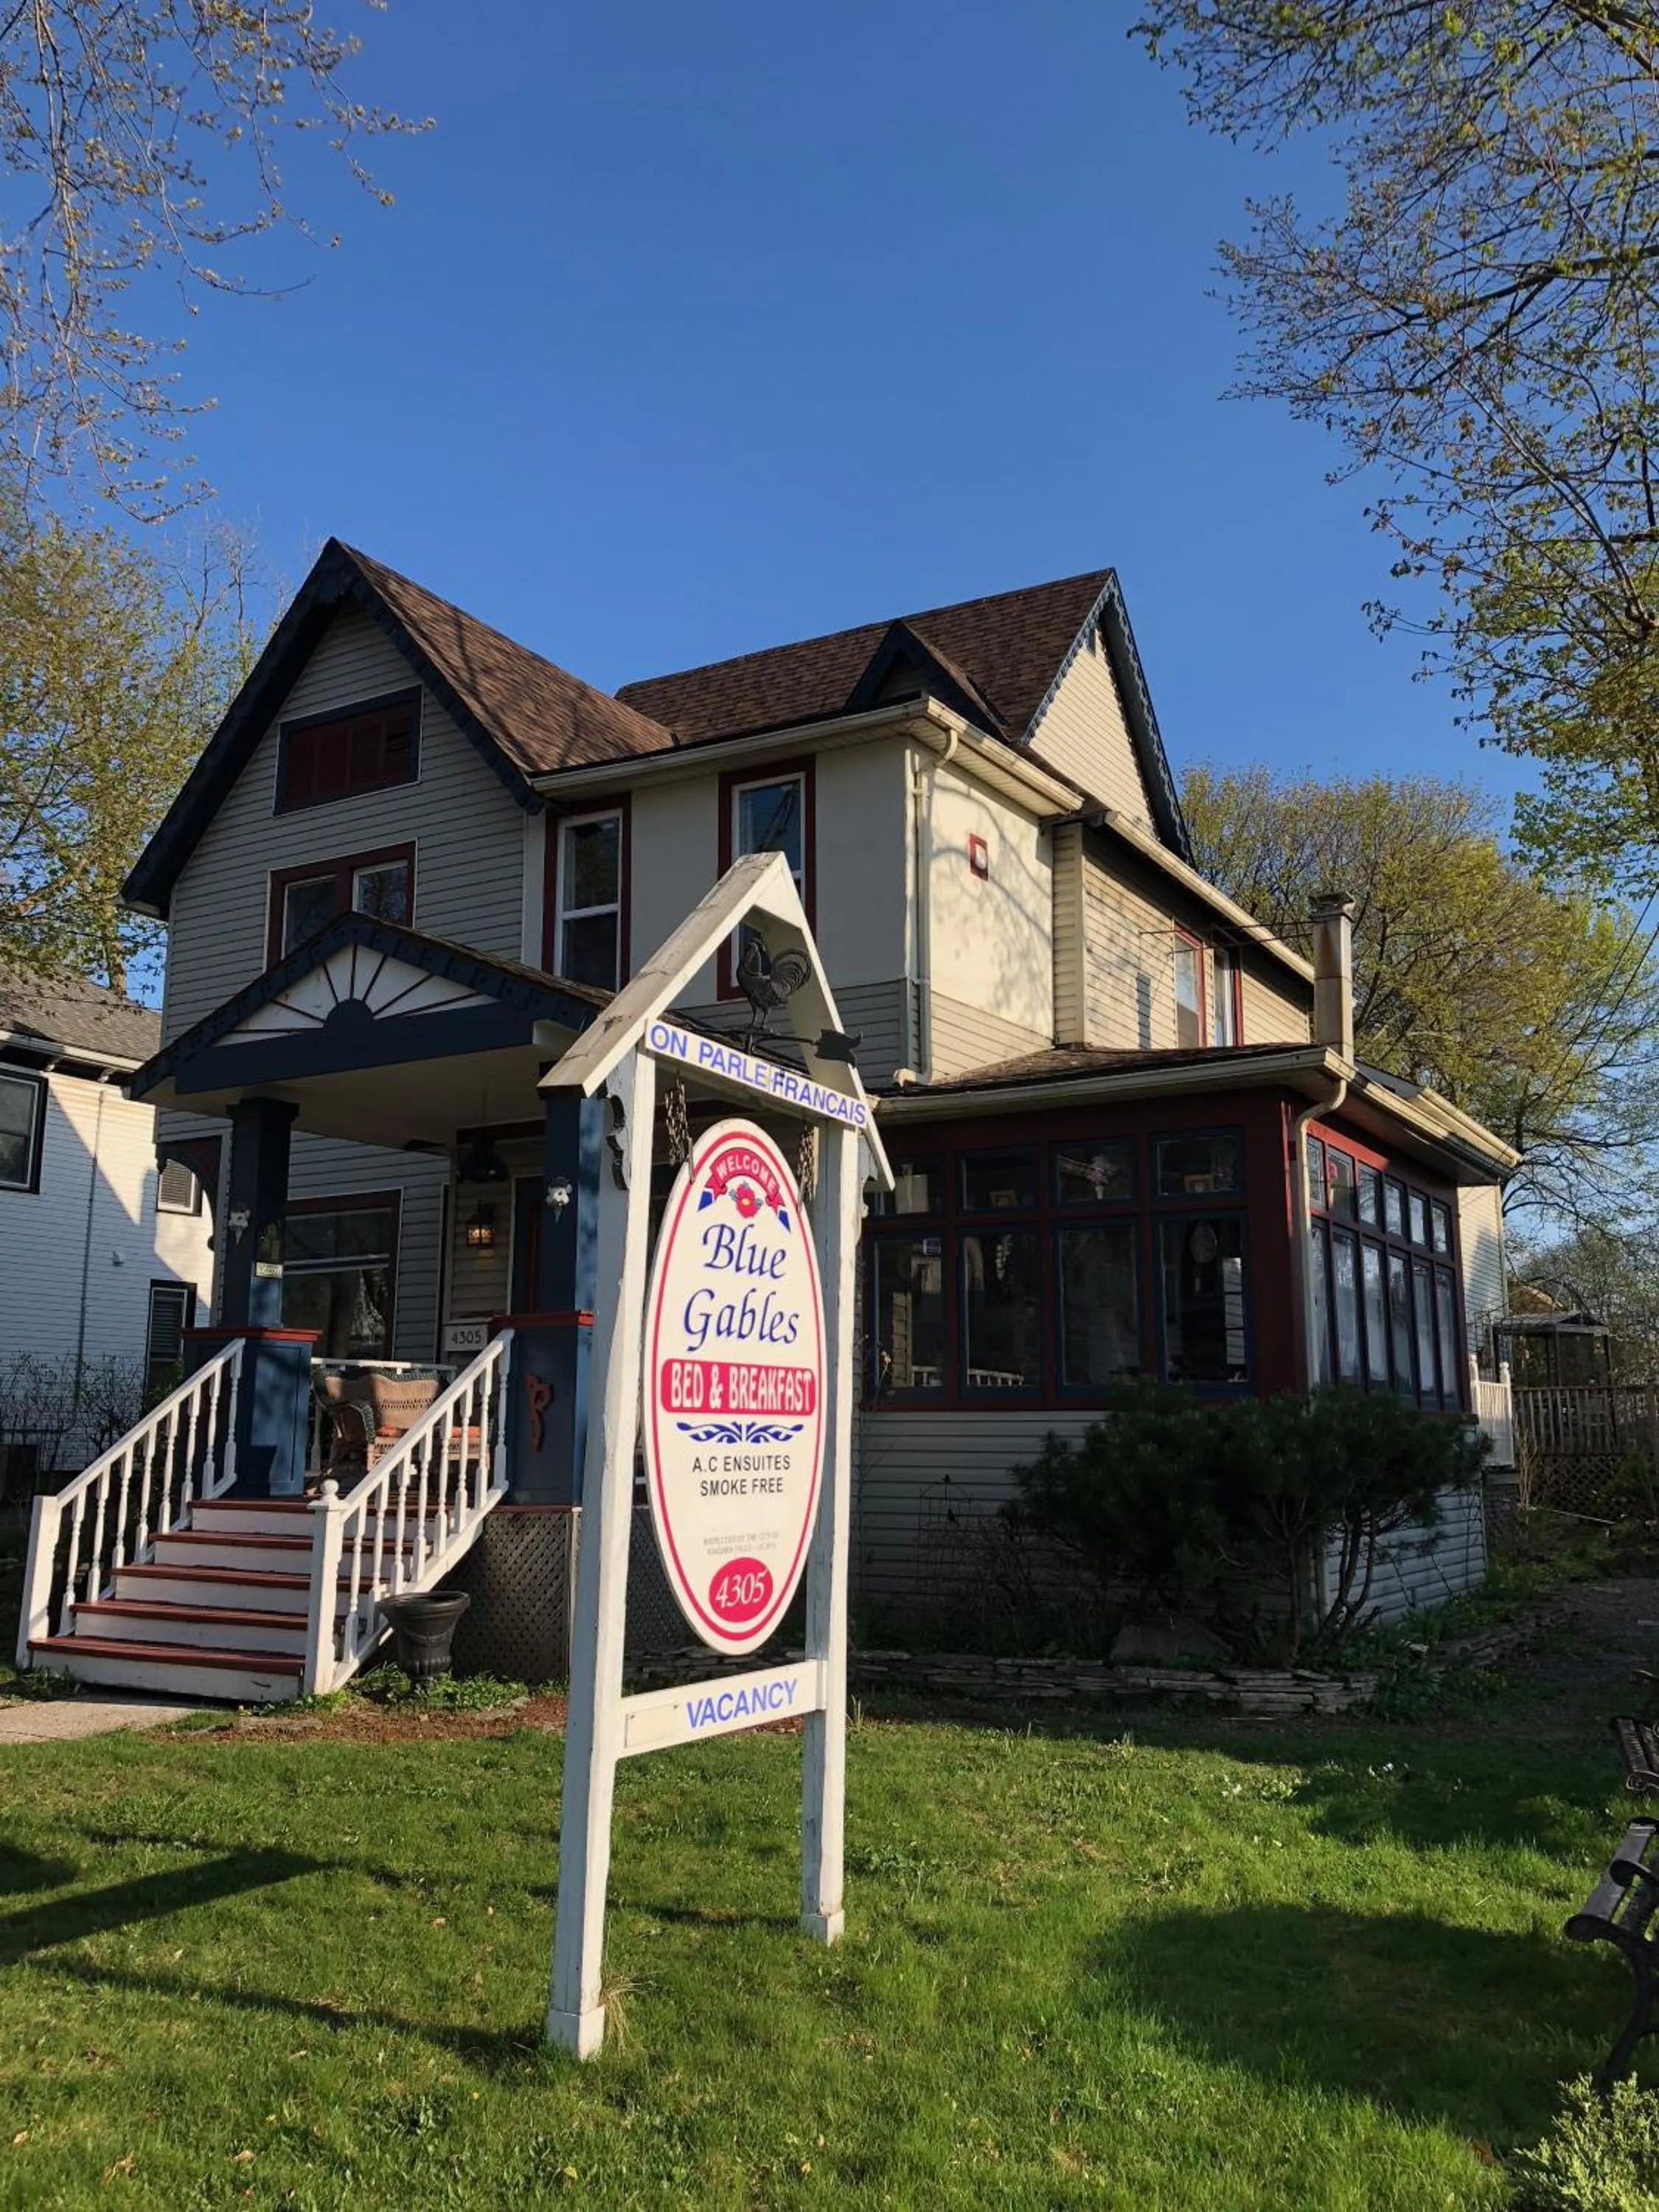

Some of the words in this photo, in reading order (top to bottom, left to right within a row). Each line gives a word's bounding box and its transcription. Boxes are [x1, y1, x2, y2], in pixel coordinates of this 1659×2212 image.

[650, 1024, 687, 1057] ON
[698, 1041, 768, 1090] PARLE
[772, 1071, 866, 1125] FRANCAIS
[716, 1155, 778, 1196] WELCOME
[702, 1223, 787, 1279] Blue
[451, 1330, 481, 1345] 4305
[684, 1288, 800, 1352] Gables
[671, 1362, 703, 1408] BED
[709, 1364, 724, 1409] &
[728, 1366, 813, 1412] BREAKFAST
[692, 1456, 718, 1472] A.C
[723, 1455, 791, 1472] ENSUITES
[700, 1478, 747, 1496] SMOKE
[752, 1477, 784, 1493] FREE
[714, 1568, 768, 1609] 4305
[686, 1678, 797, 1729] VACANCY
